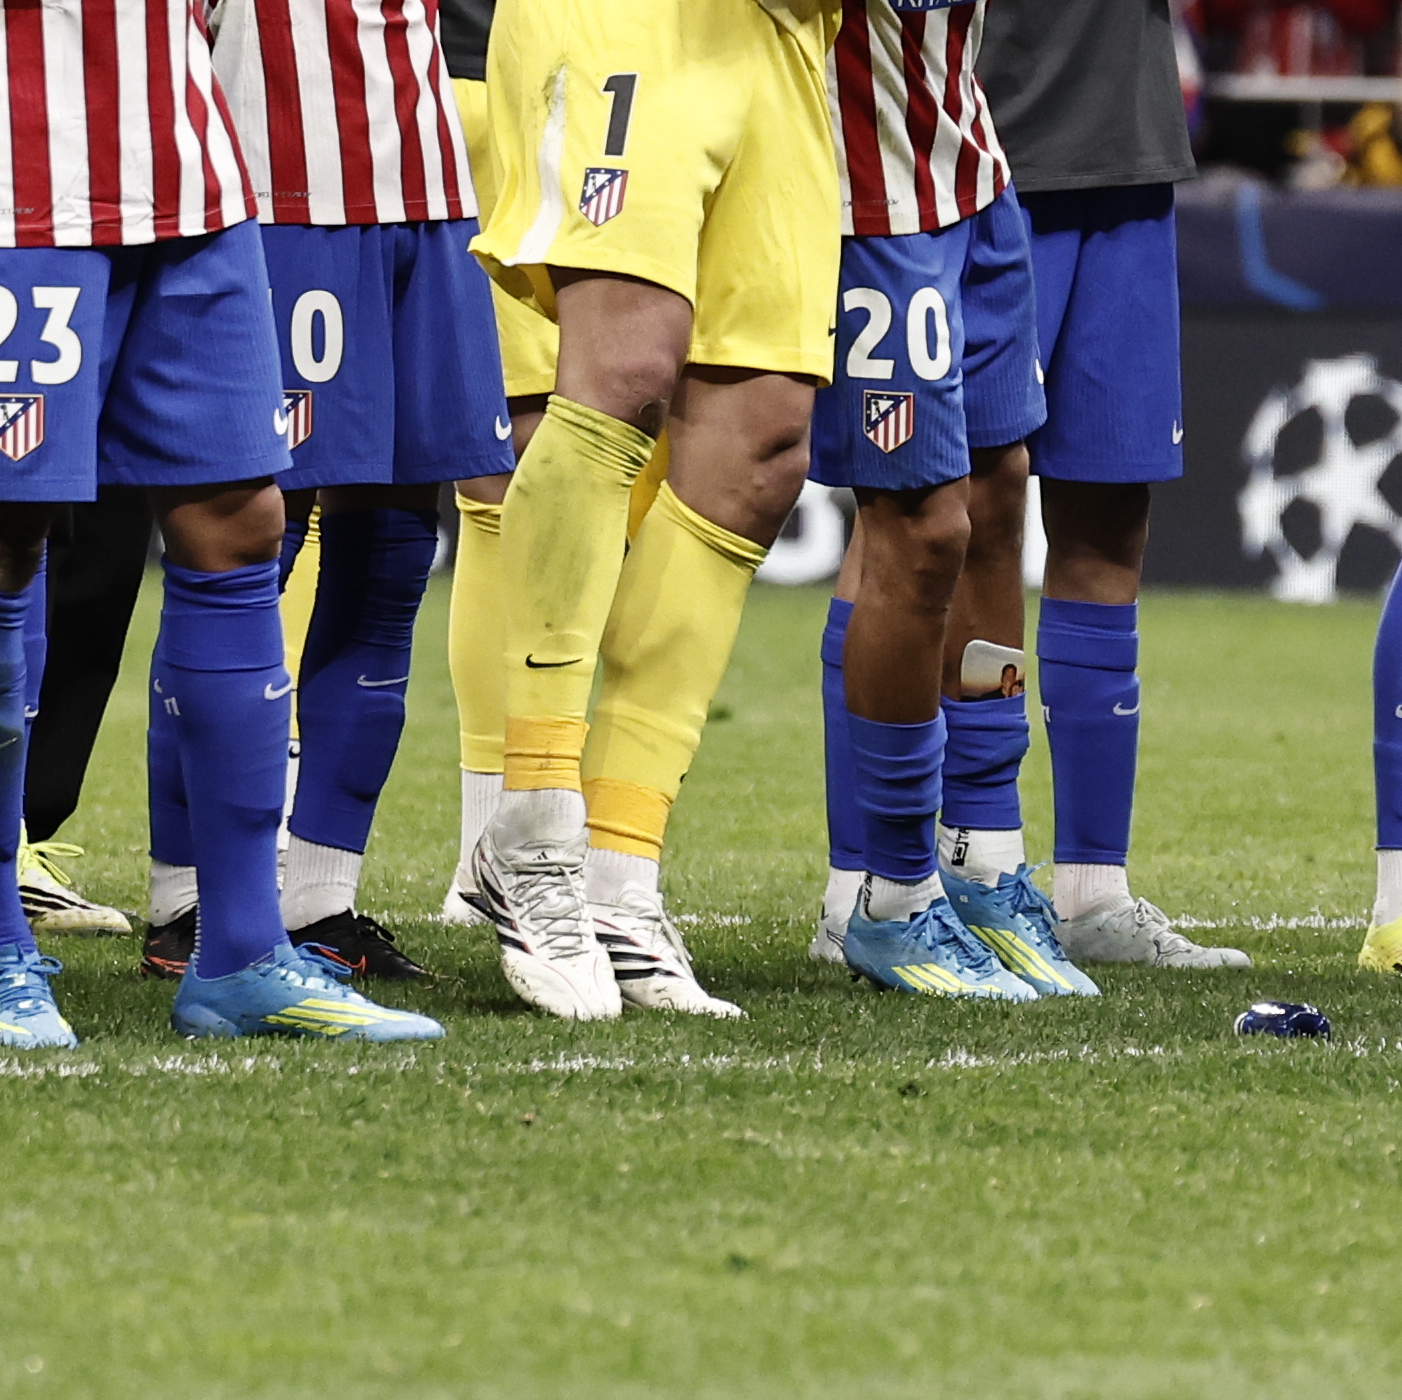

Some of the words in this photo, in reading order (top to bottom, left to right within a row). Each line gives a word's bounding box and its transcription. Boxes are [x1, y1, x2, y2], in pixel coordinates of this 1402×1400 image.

[601, 72, 638, 157] 1
[268, 288, 344, 383] 0
[843, 287, 952, 381] 20
